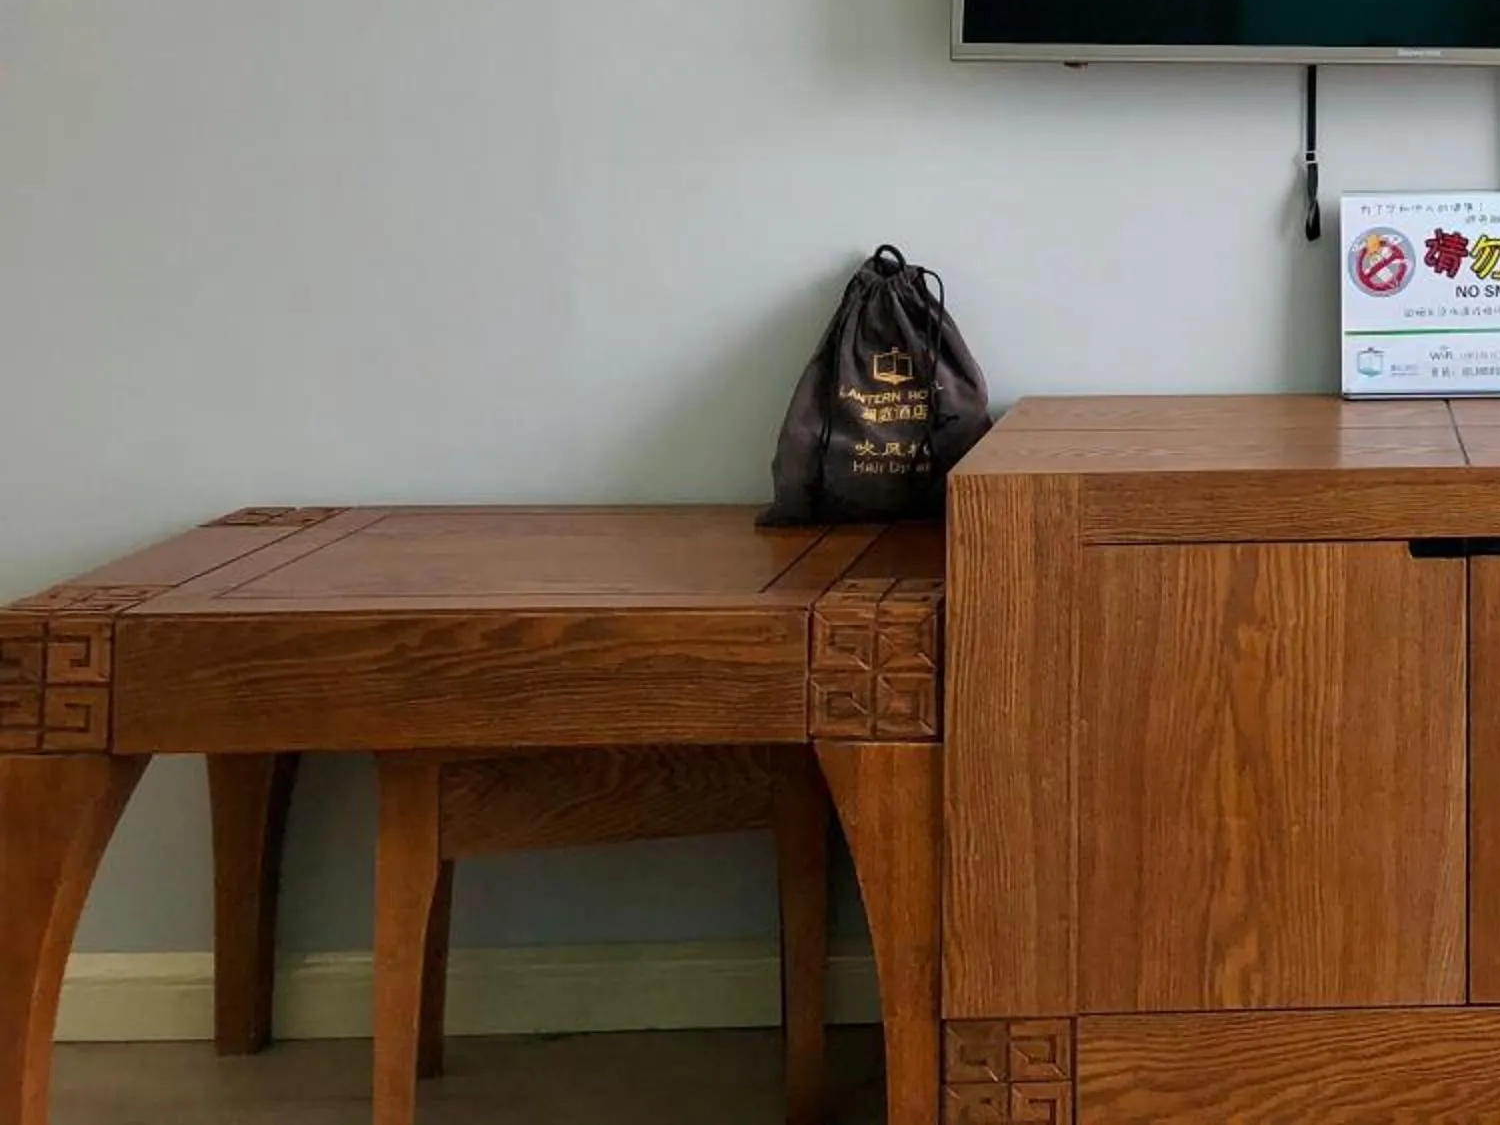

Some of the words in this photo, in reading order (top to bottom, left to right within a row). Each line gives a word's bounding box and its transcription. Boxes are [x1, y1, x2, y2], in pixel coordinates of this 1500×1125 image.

[1455, 285, 1480, 298] NO
[839, 384, 901, 404] LANTERN
[853, 460, 883, 474] Hair
